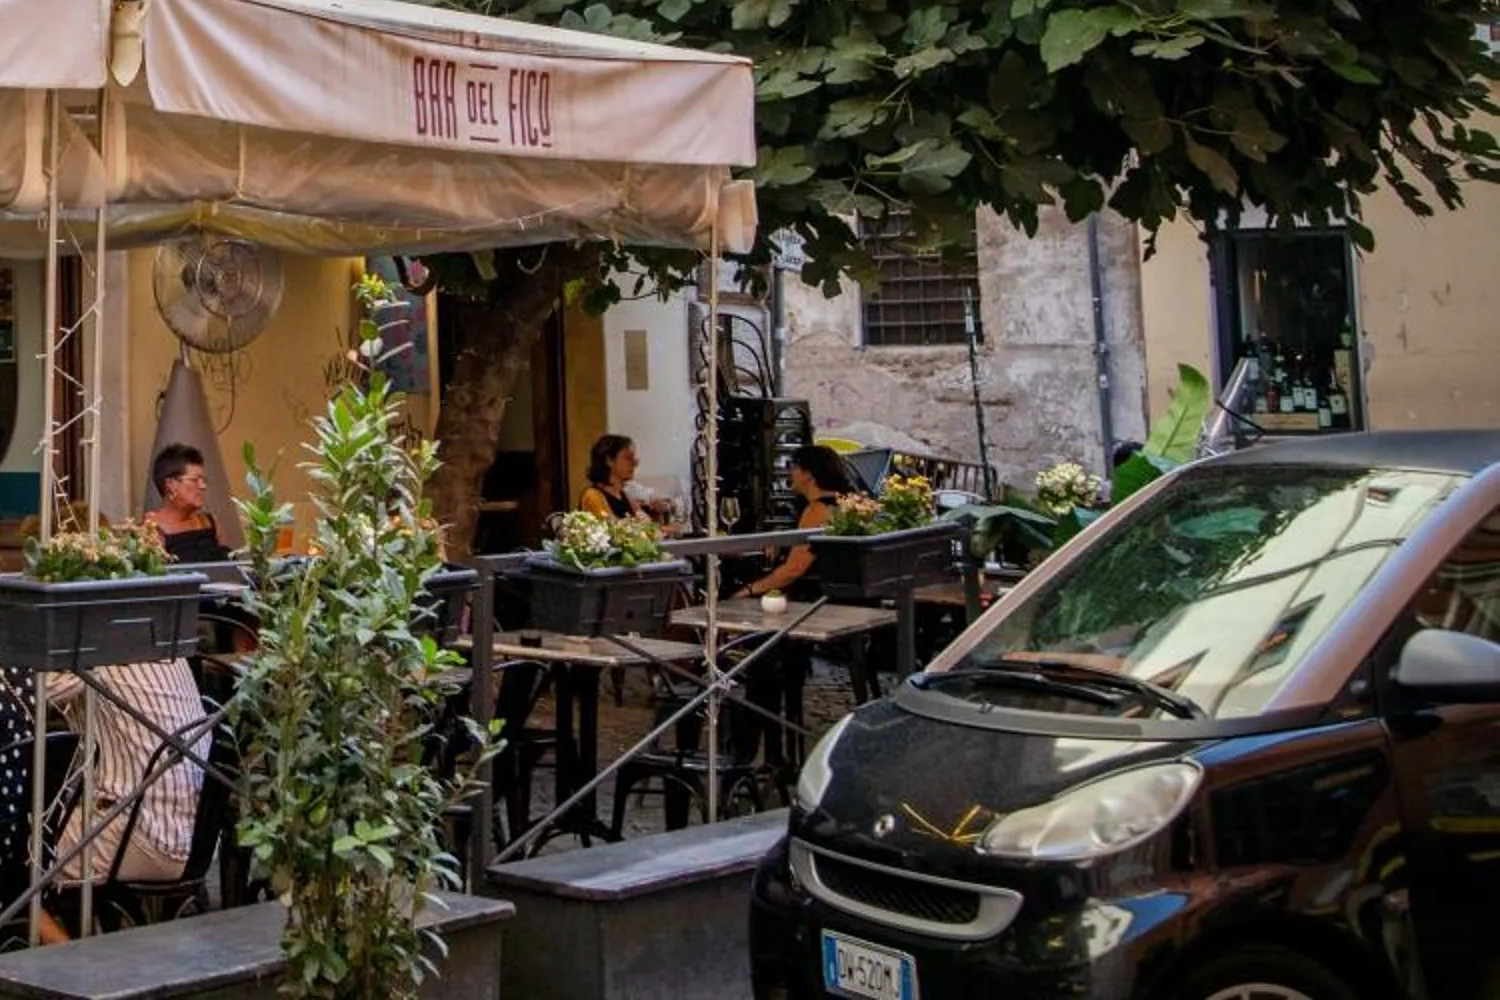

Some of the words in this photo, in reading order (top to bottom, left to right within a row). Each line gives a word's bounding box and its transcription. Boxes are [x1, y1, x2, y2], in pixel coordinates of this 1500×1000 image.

[414, 56, 458, 140] BAR
[467, 81, 498, 125] DEL
[509, 68, 551, 147] FICO
